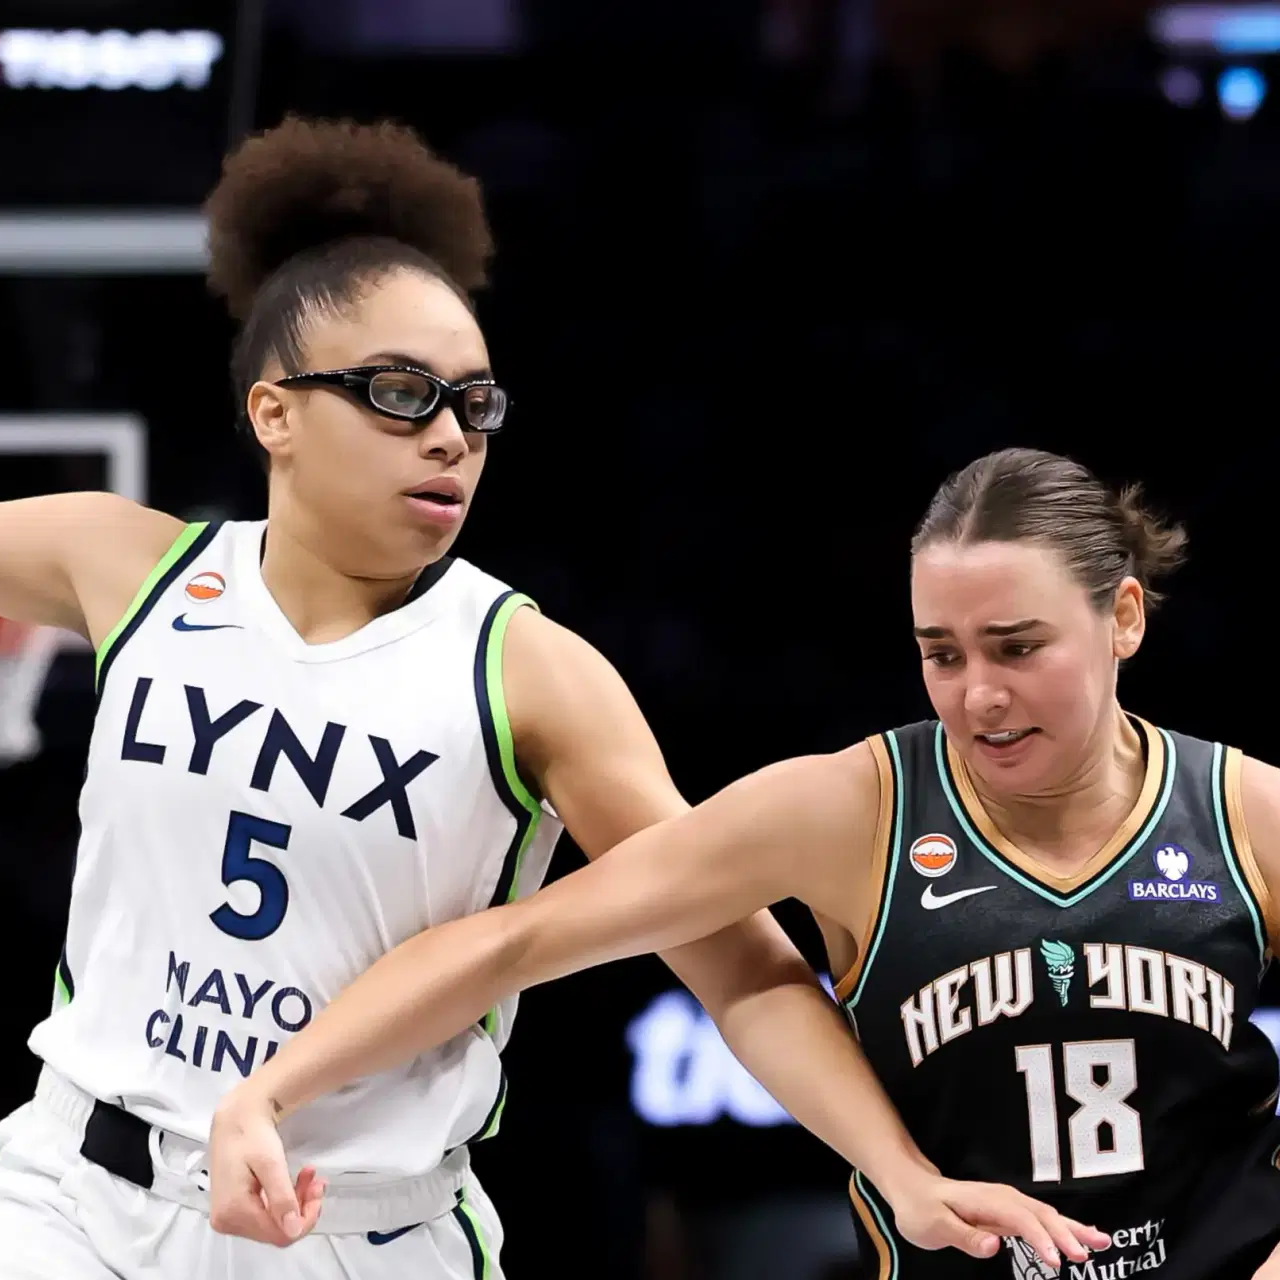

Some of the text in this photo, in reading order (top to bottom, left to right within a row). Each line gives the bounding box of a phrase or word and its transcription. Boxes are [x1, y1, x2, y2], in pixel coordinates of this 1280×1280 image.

[120, 677, 440, 841] LYNX
[208, 810, 292, 941] 5
[1132, 882, 1217, 900] BARCLAYS
[166, 950, 312, 1032] MAYO
[900, 947, 1032, 1067] NEW
[1083, 943, 1234, 1052] YORK
[146, 1009, 278, 1078] CLIN
[1015, 1039, 1144, 1183] 18
[1084, 1218, 1165, 1253] erty
